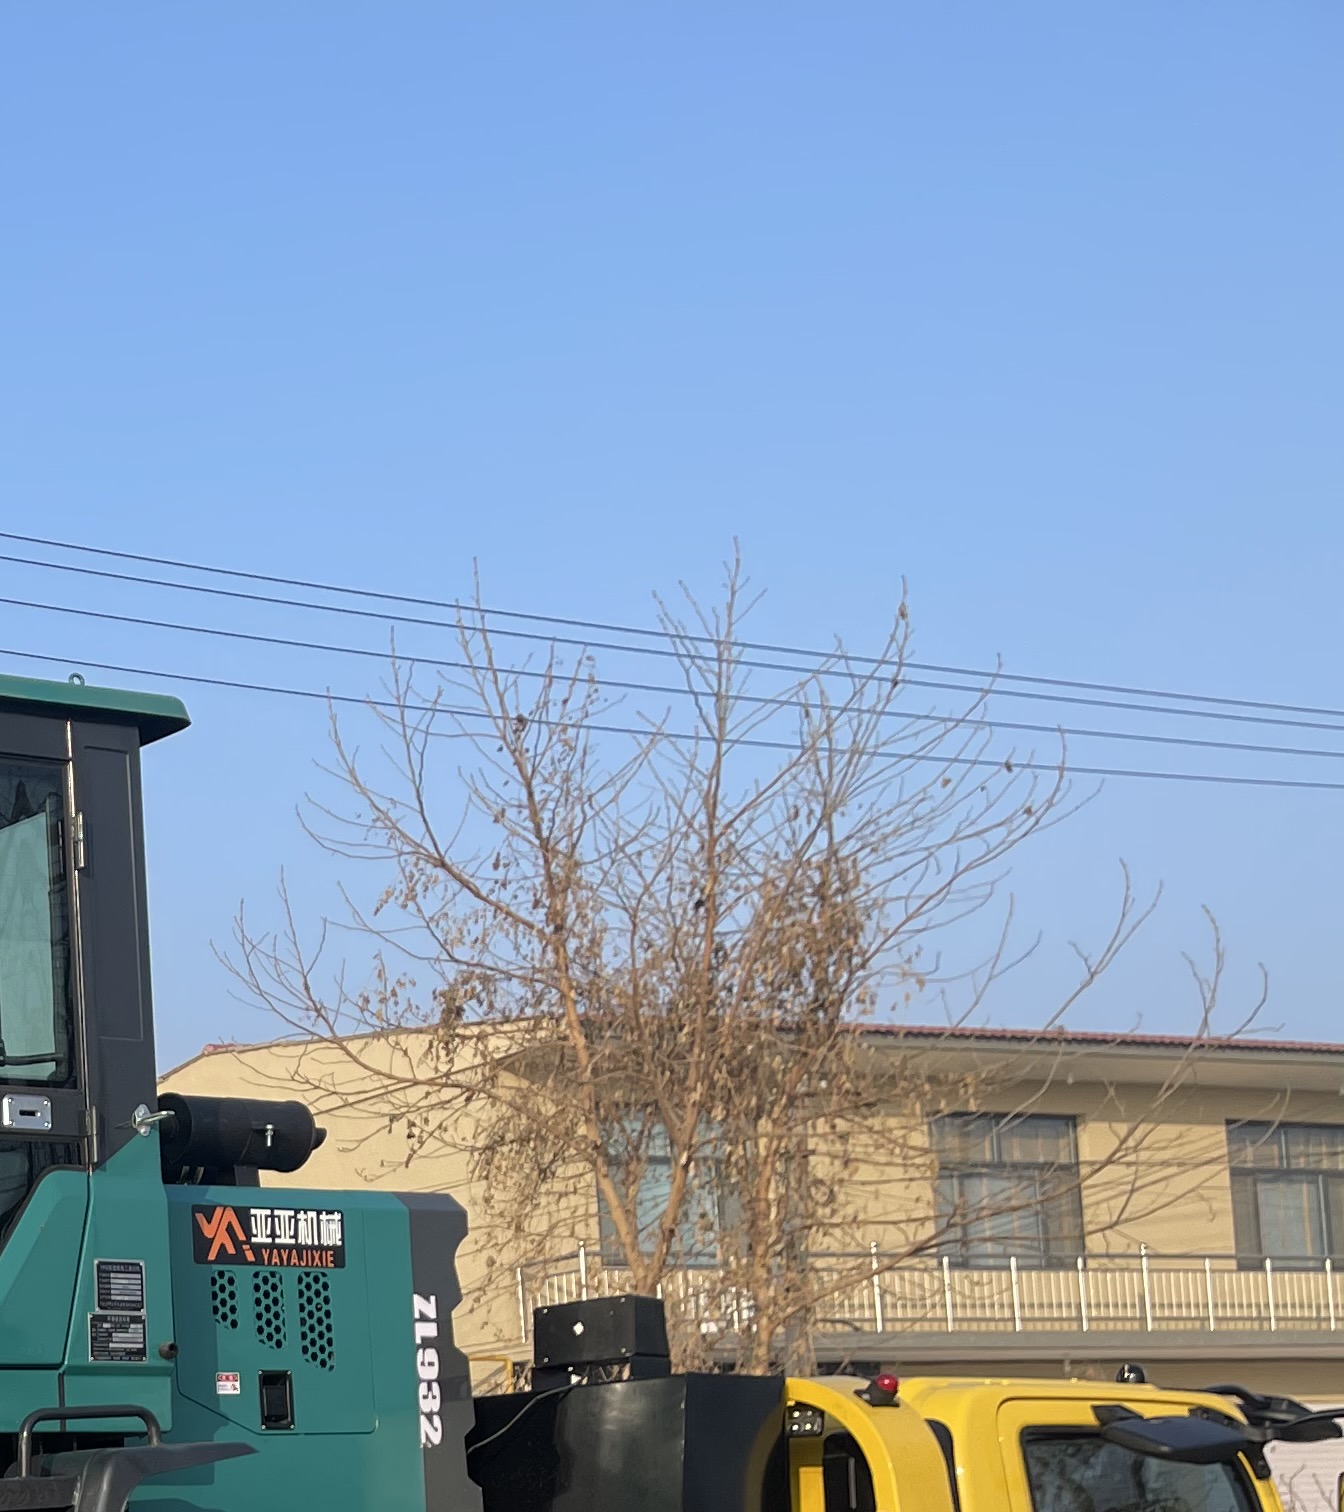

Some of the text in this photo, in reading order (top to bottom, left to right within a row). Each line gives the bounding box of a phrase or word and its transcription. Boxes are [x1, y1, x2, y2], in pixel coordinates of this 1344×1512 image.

[250, 1208, 342, 1246] 亚亚机械
[262, 1248, 335, 1267] YAYAJIXIE
[413, 1293, 443, 1449] ZL932
